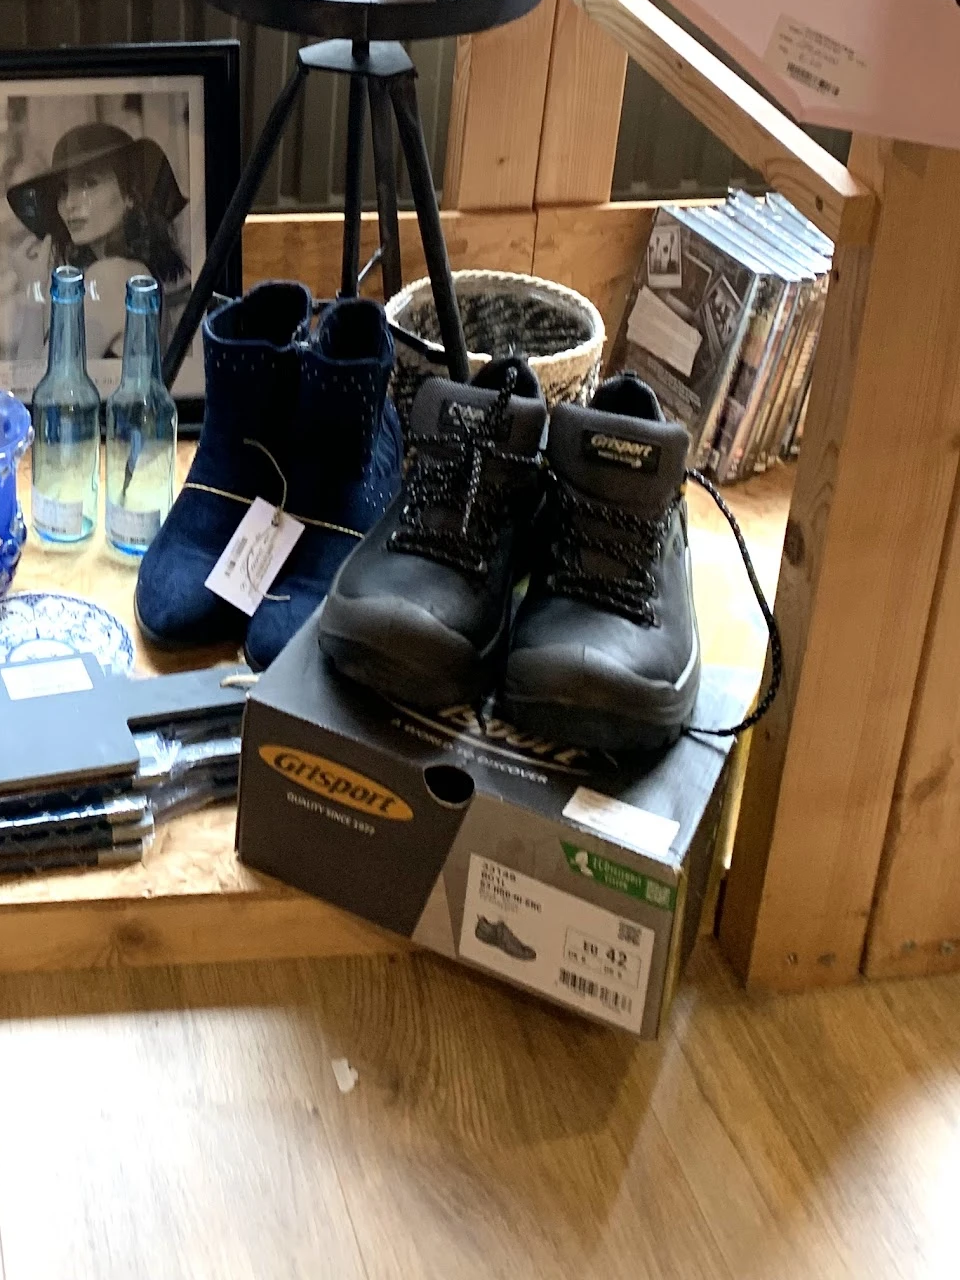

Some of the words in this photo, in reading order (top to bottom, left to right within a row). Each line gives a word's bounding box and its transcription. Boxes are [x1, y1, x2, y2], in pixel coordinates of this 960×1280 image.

[273, 752, 397, 813] Grisport
[286, 791, 324, 814] QUALITY
[606, 946, 627, 970] 42
